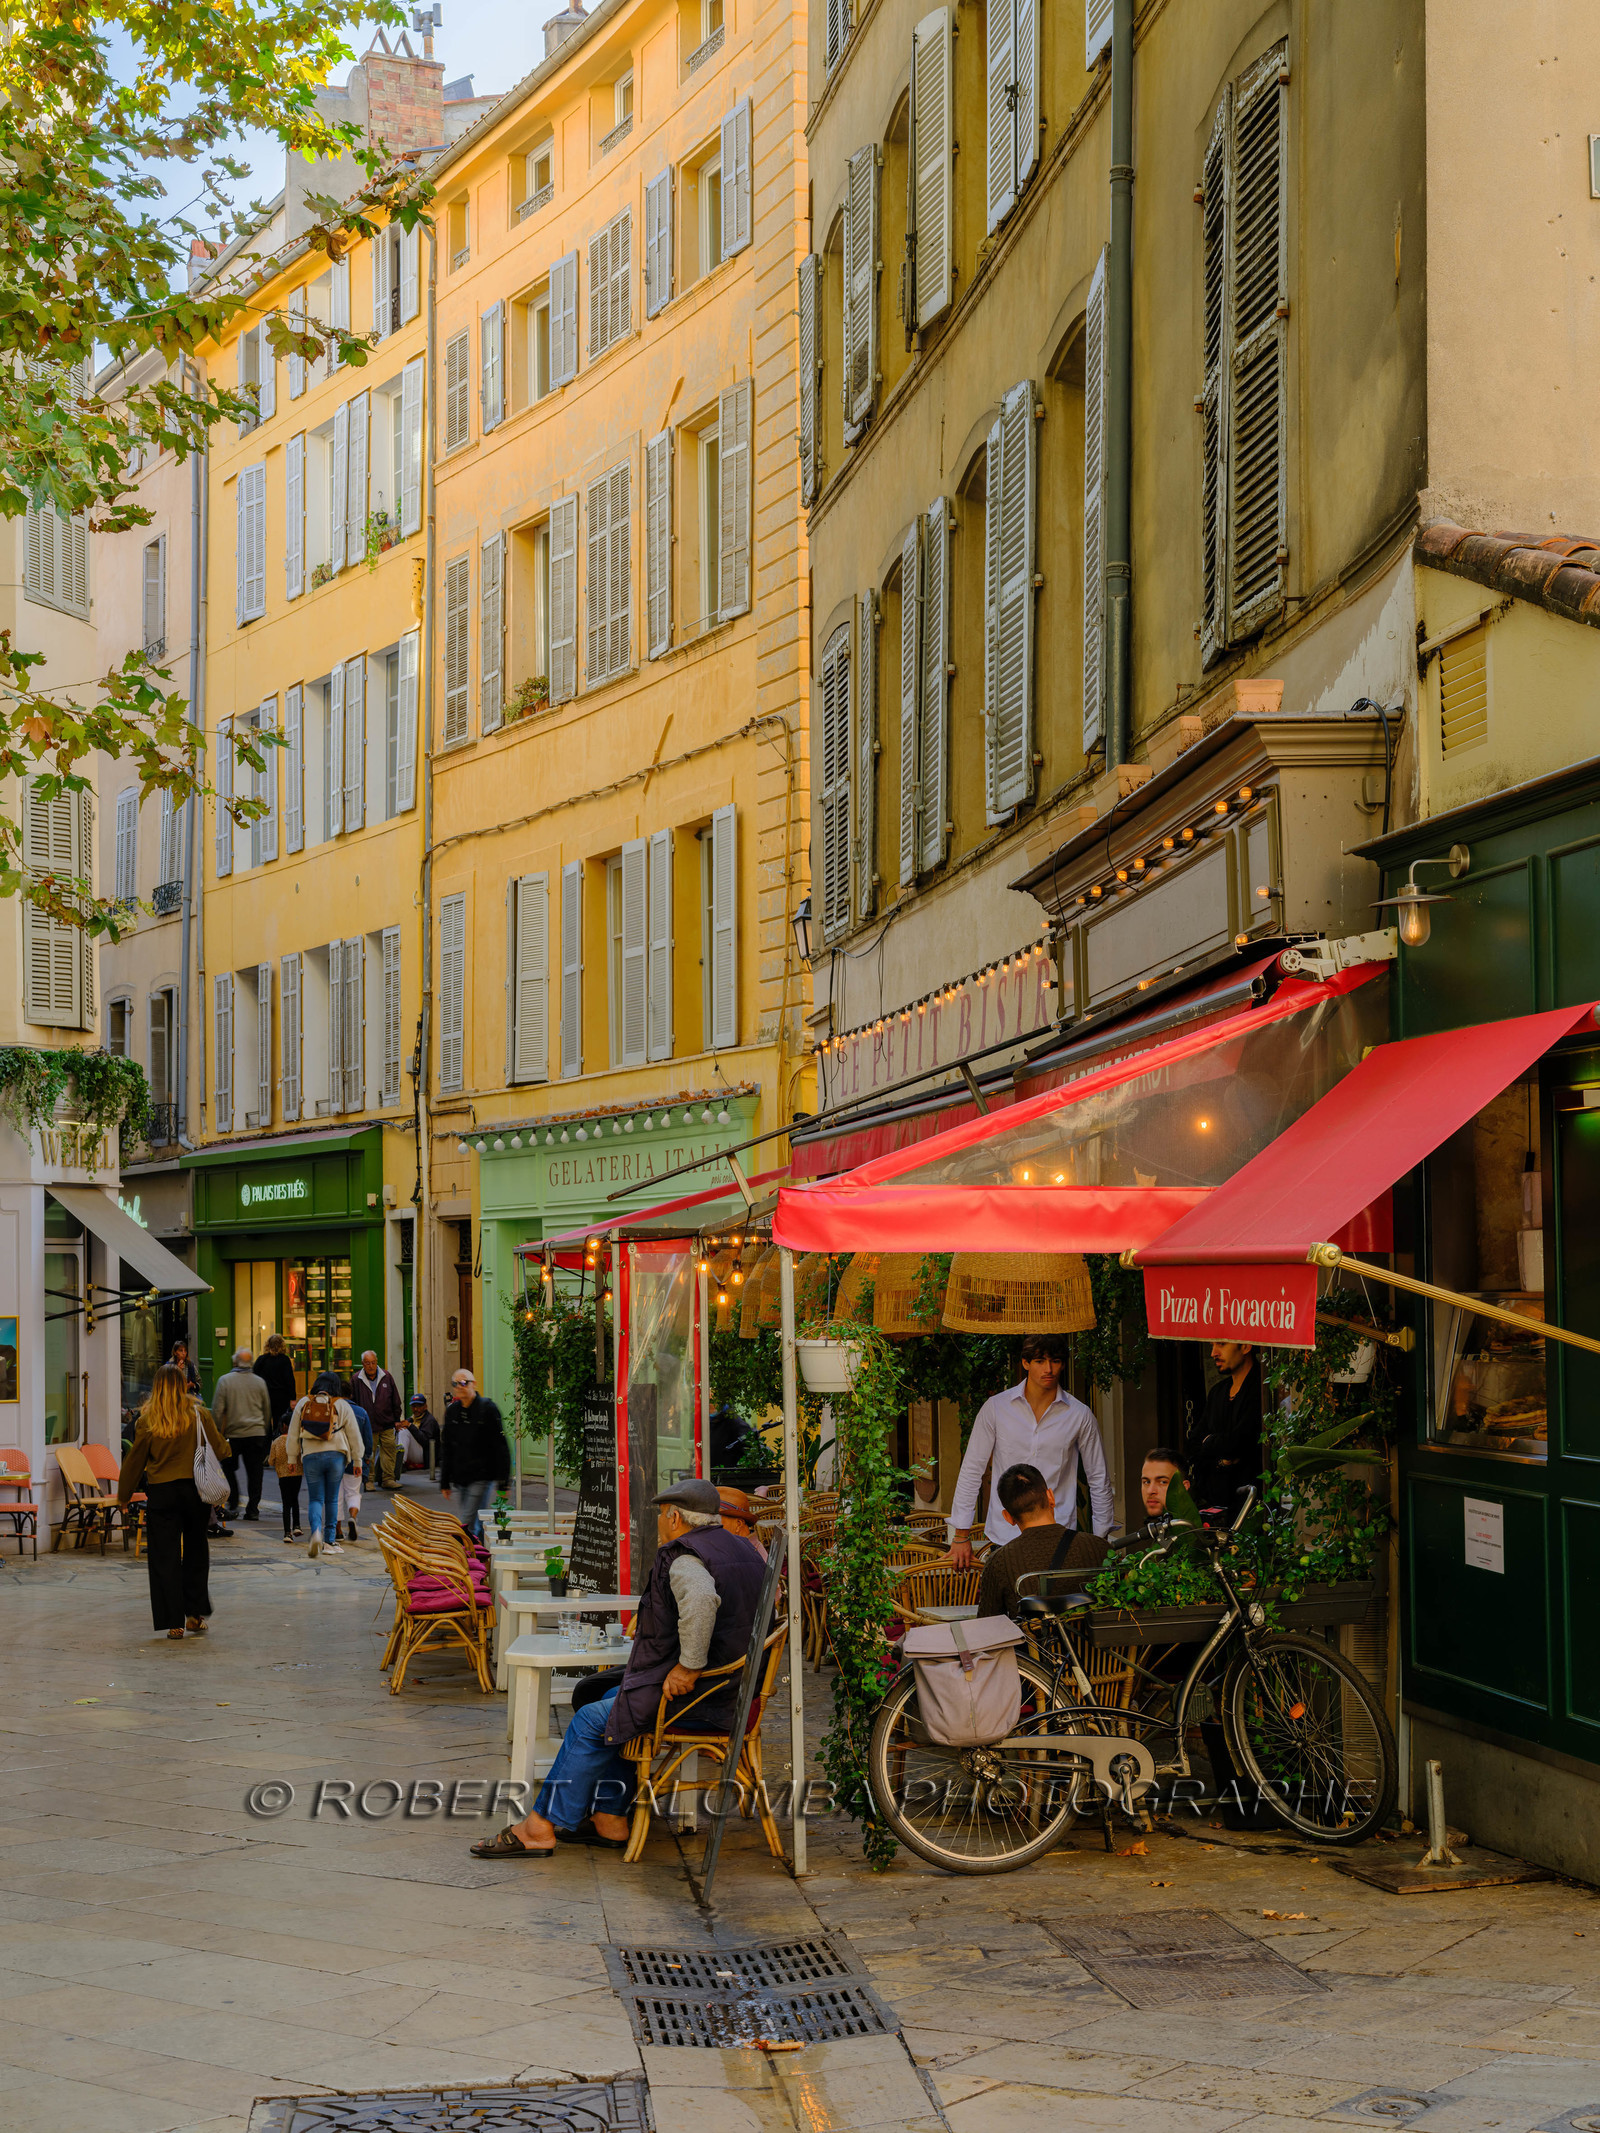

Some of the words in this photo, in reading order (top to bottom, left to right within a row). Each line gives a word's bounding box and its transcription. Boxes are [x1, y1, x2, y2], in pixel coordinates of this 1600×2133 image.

[872, 1006, 942, 1087] PETIT
[548, 1152, 655, 1187] GELATERIA
[252, 1184, 274, 1202] PALAIS
[274, 1182, 287, 1200] DES
[287, 1178, 305, 1198] THÉS
[1159, 1284, 1199, 1324] Pizza
[1202, 1287, 1214, 1325] &
[1219, 1285, 1296, 1330] Focaccia
